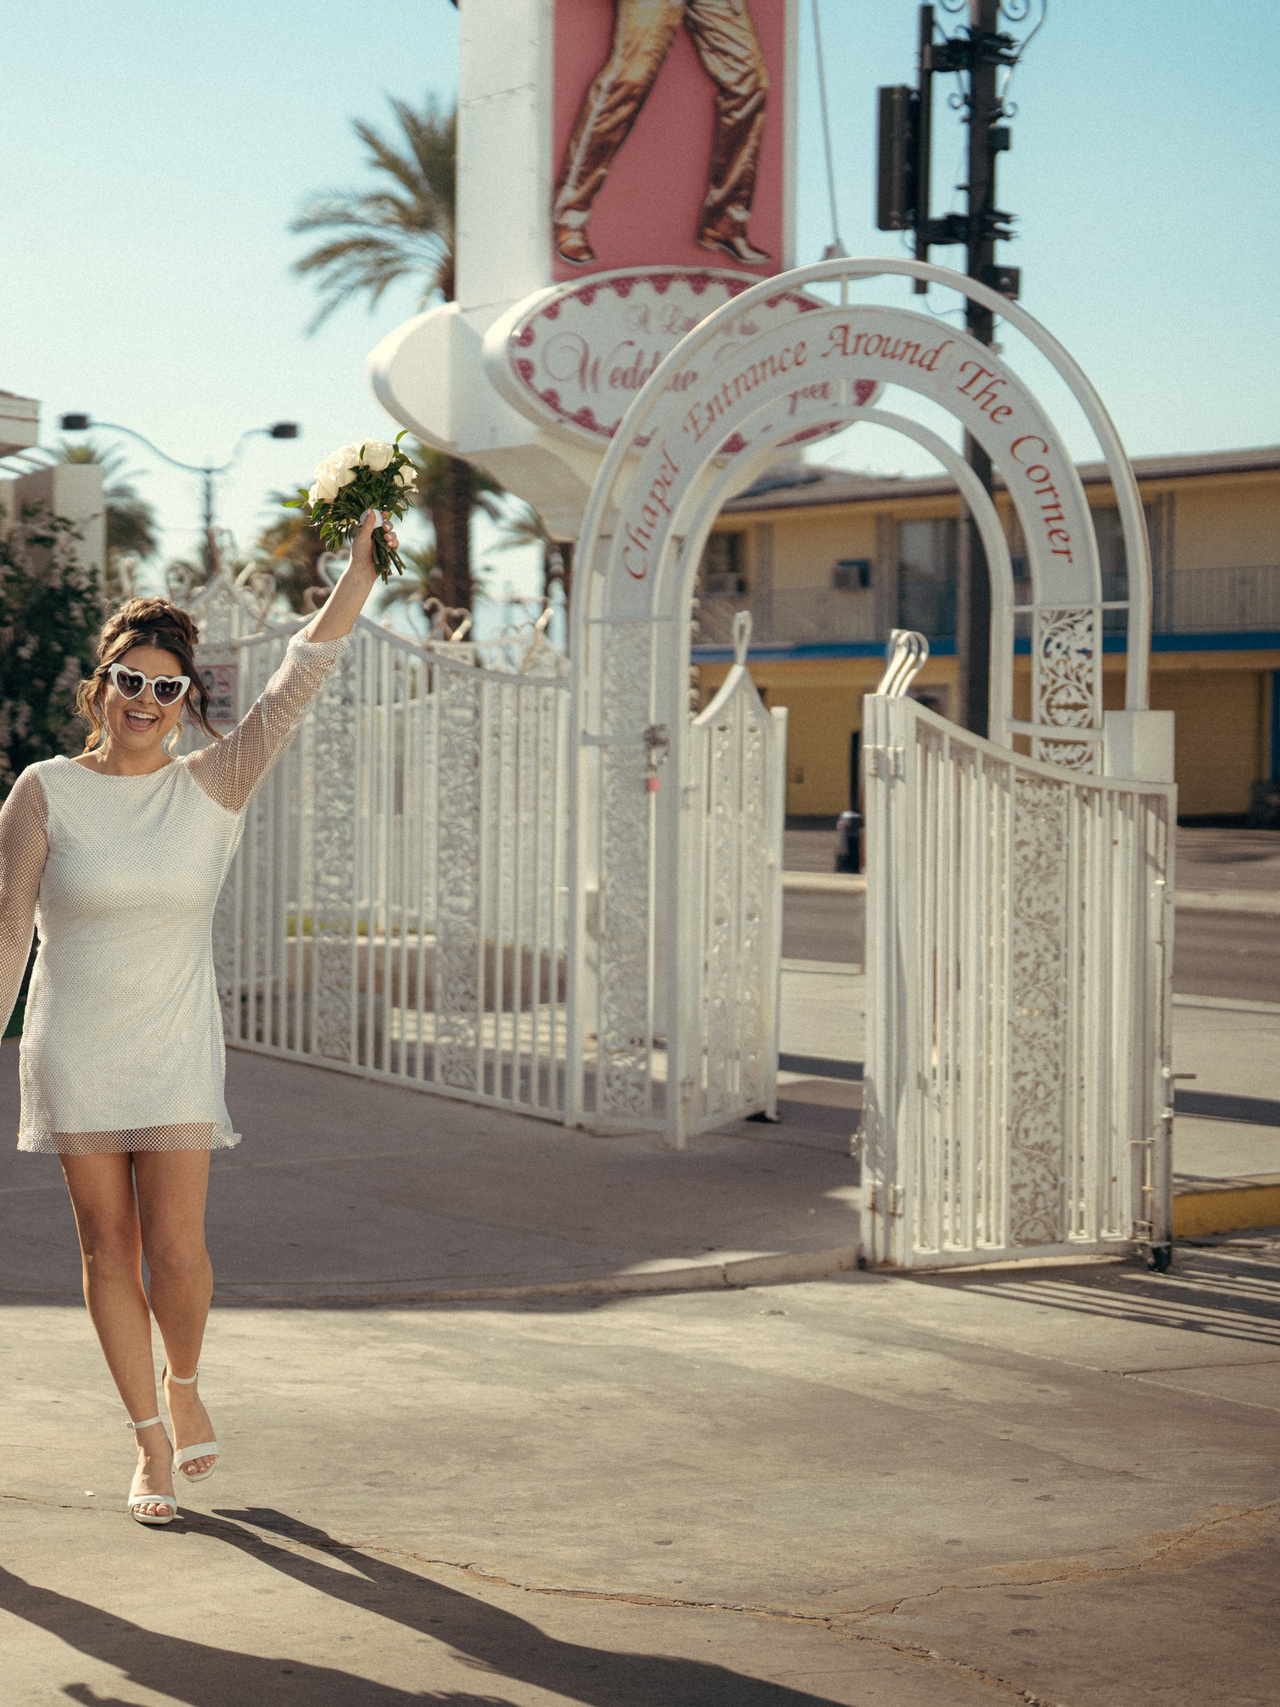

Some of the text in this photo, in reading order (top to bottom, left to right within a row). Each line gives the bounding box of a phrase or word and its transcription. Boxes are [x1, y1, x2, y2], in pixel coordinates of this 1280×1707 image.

[623, 446, 680, 580] Chapel
[683, 341, 808, 443] Entrance
[821, 324, 954, 372] Around
[957, 361, 1013, 425] The
[1010, 435, 1073, 564] Corner
